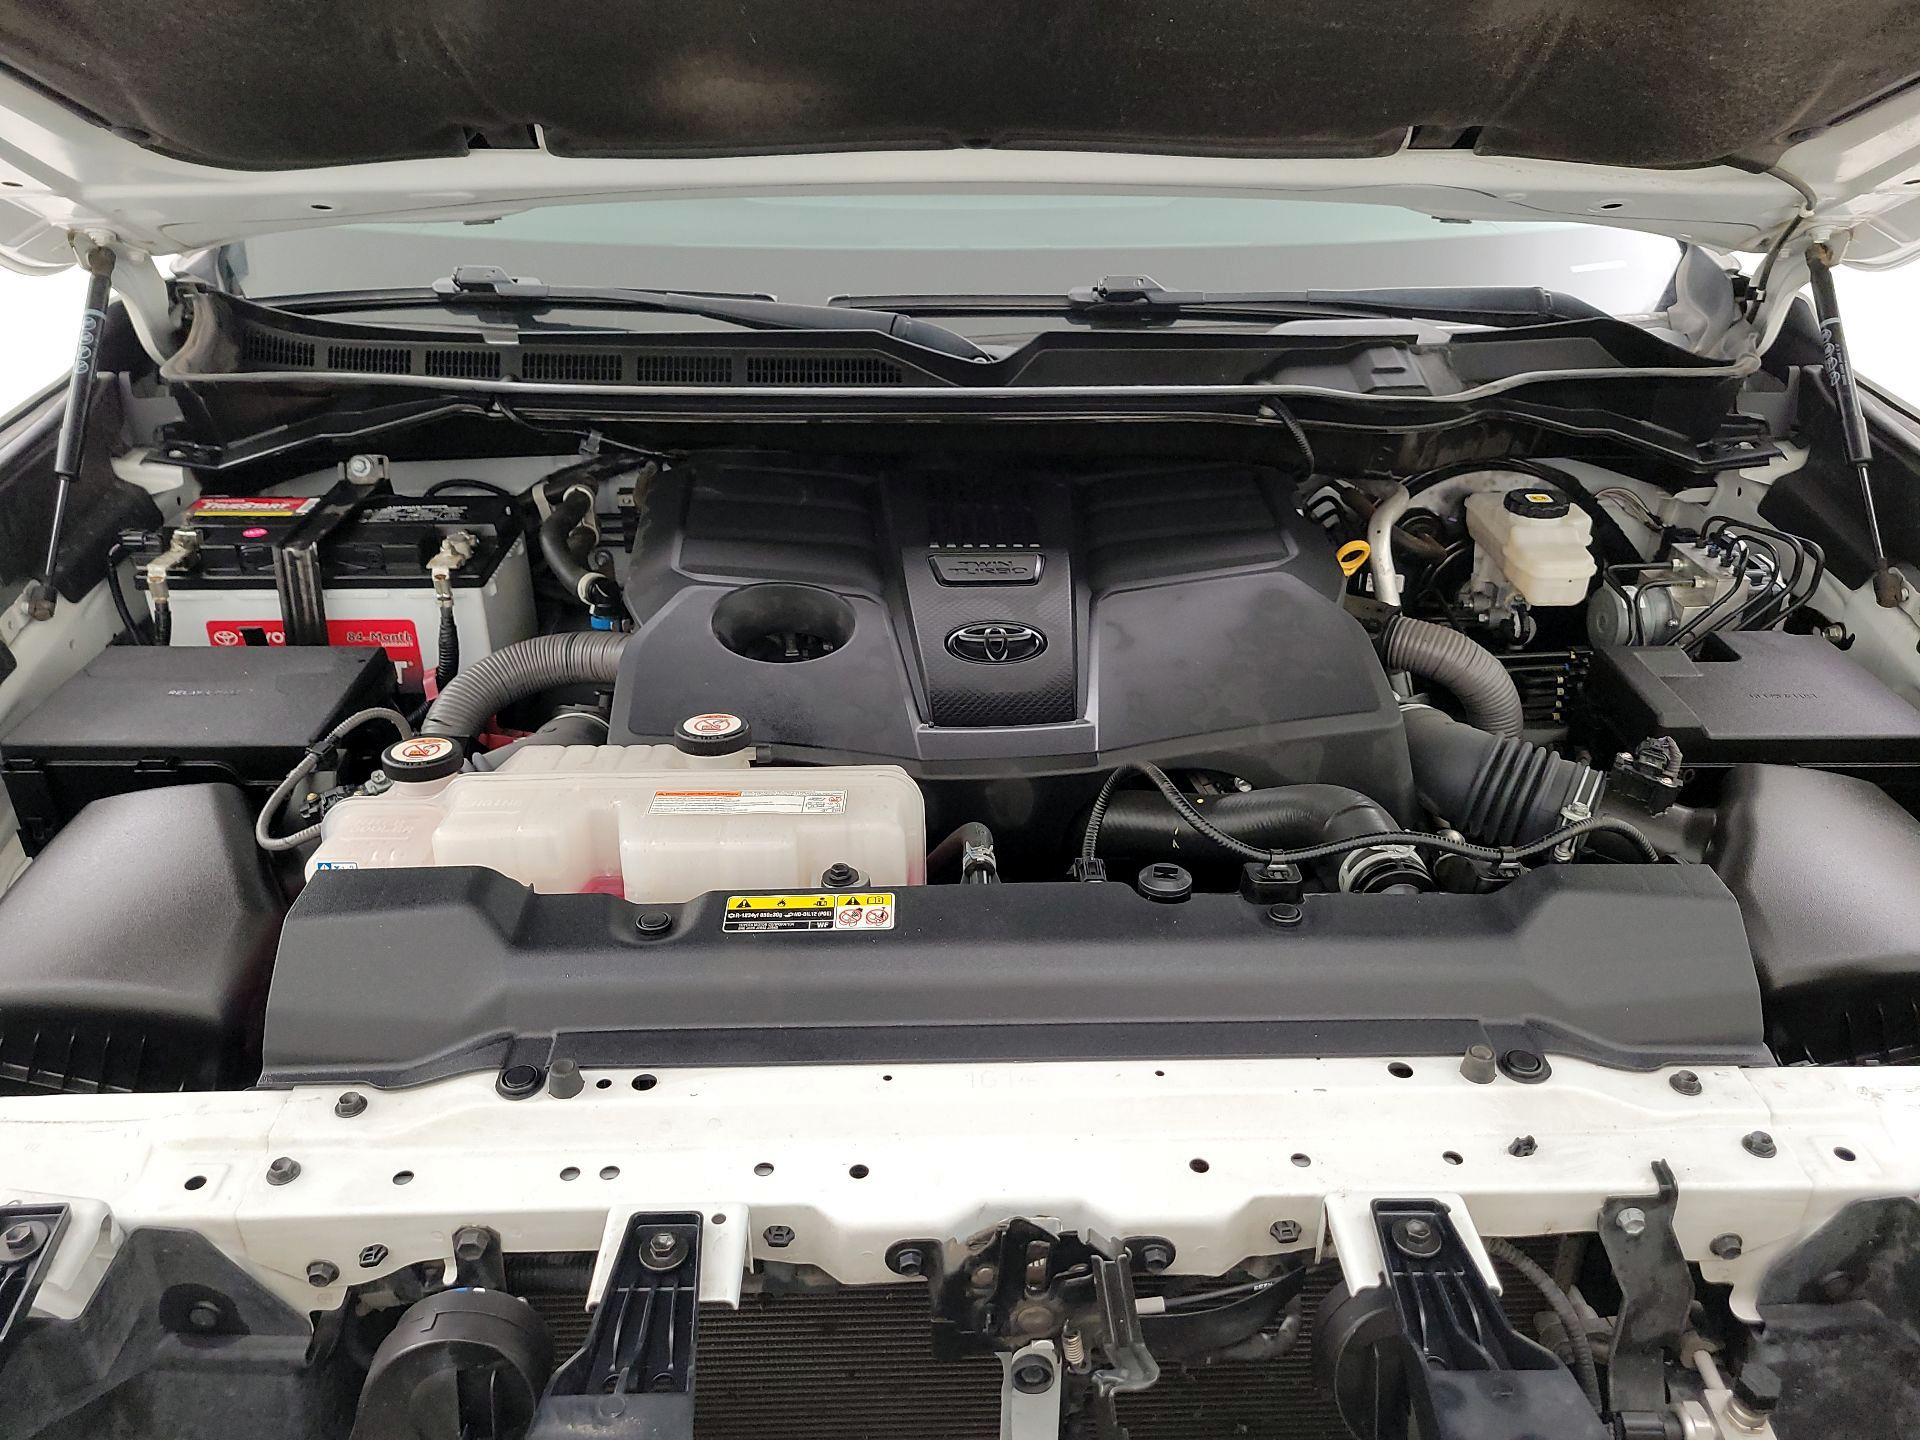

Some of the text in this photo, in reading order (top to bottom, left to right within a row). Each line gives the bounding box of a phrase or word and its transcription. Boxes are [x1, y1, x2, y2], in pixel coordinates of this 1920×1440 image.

[957, 560, 1013, 568] TWIN
[947, 567, 1028, 575] TURBO
[346, 630, 413, 644] 84-Month
[816, 921, 830, 929] WF
